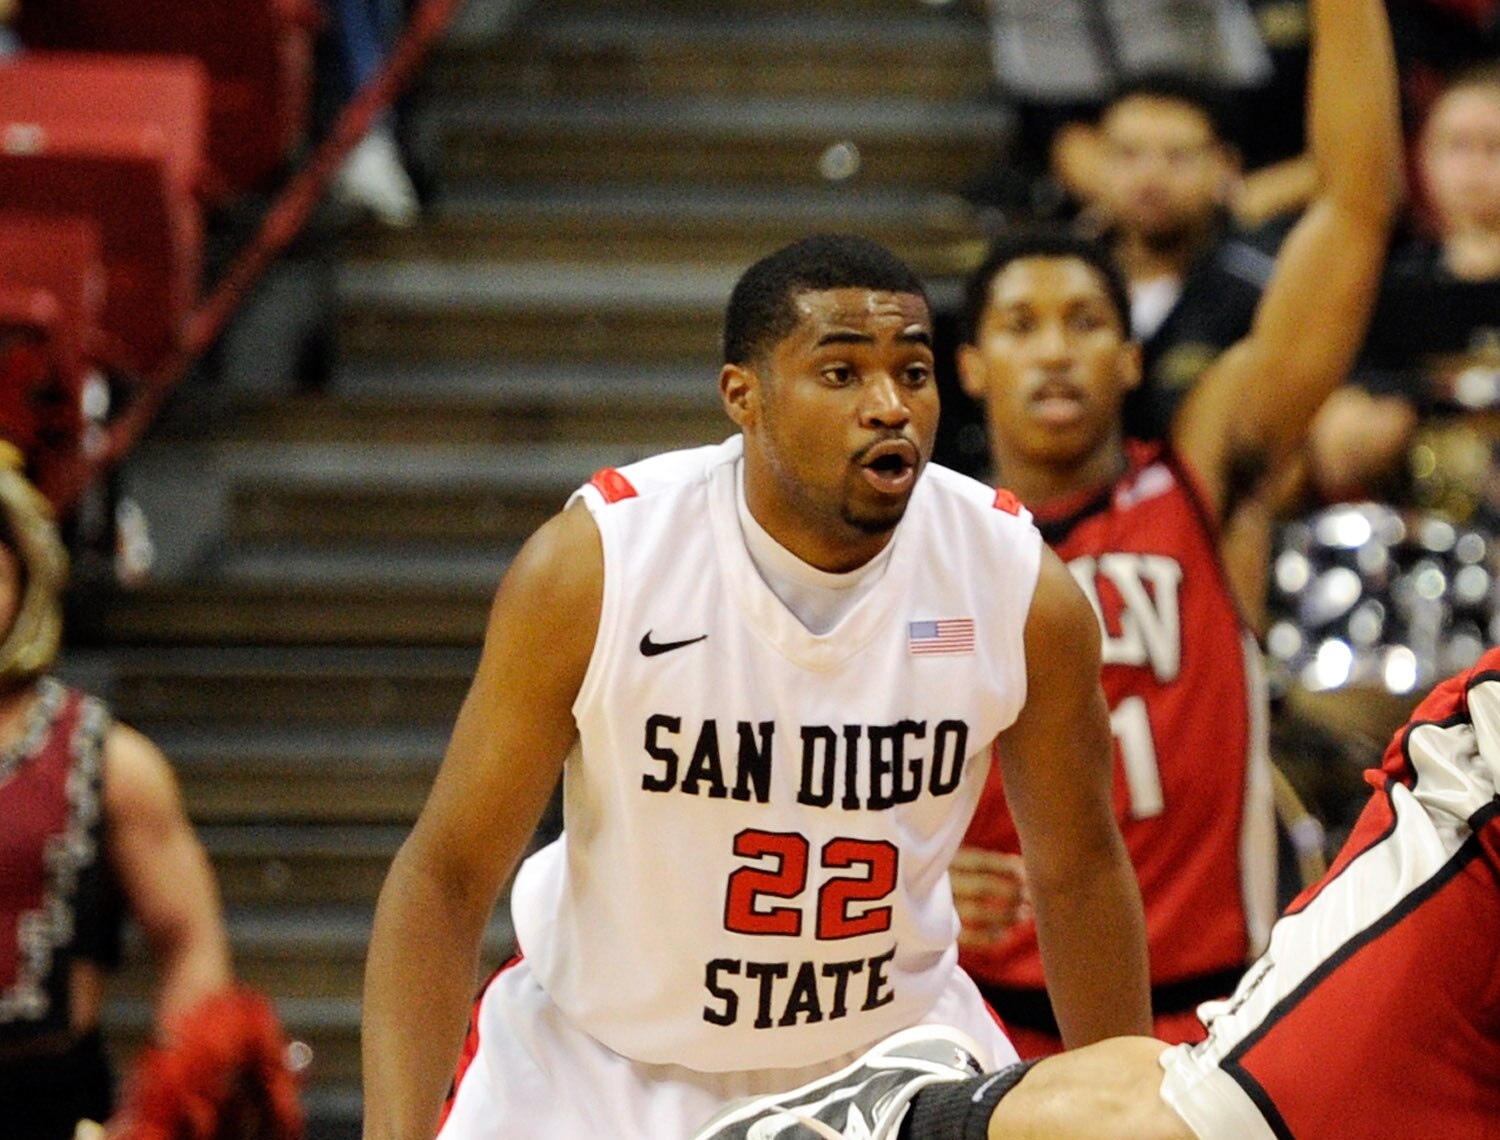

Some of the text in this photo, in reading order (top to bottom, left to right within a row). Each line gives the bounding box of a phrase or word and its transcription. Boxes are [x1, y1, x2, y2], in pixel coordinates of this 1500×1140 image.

[642, 714, 969, 811] SAN DIEGO
[723, 828, 899, 941] 22
[702, 945, 896, 1030] STATE
